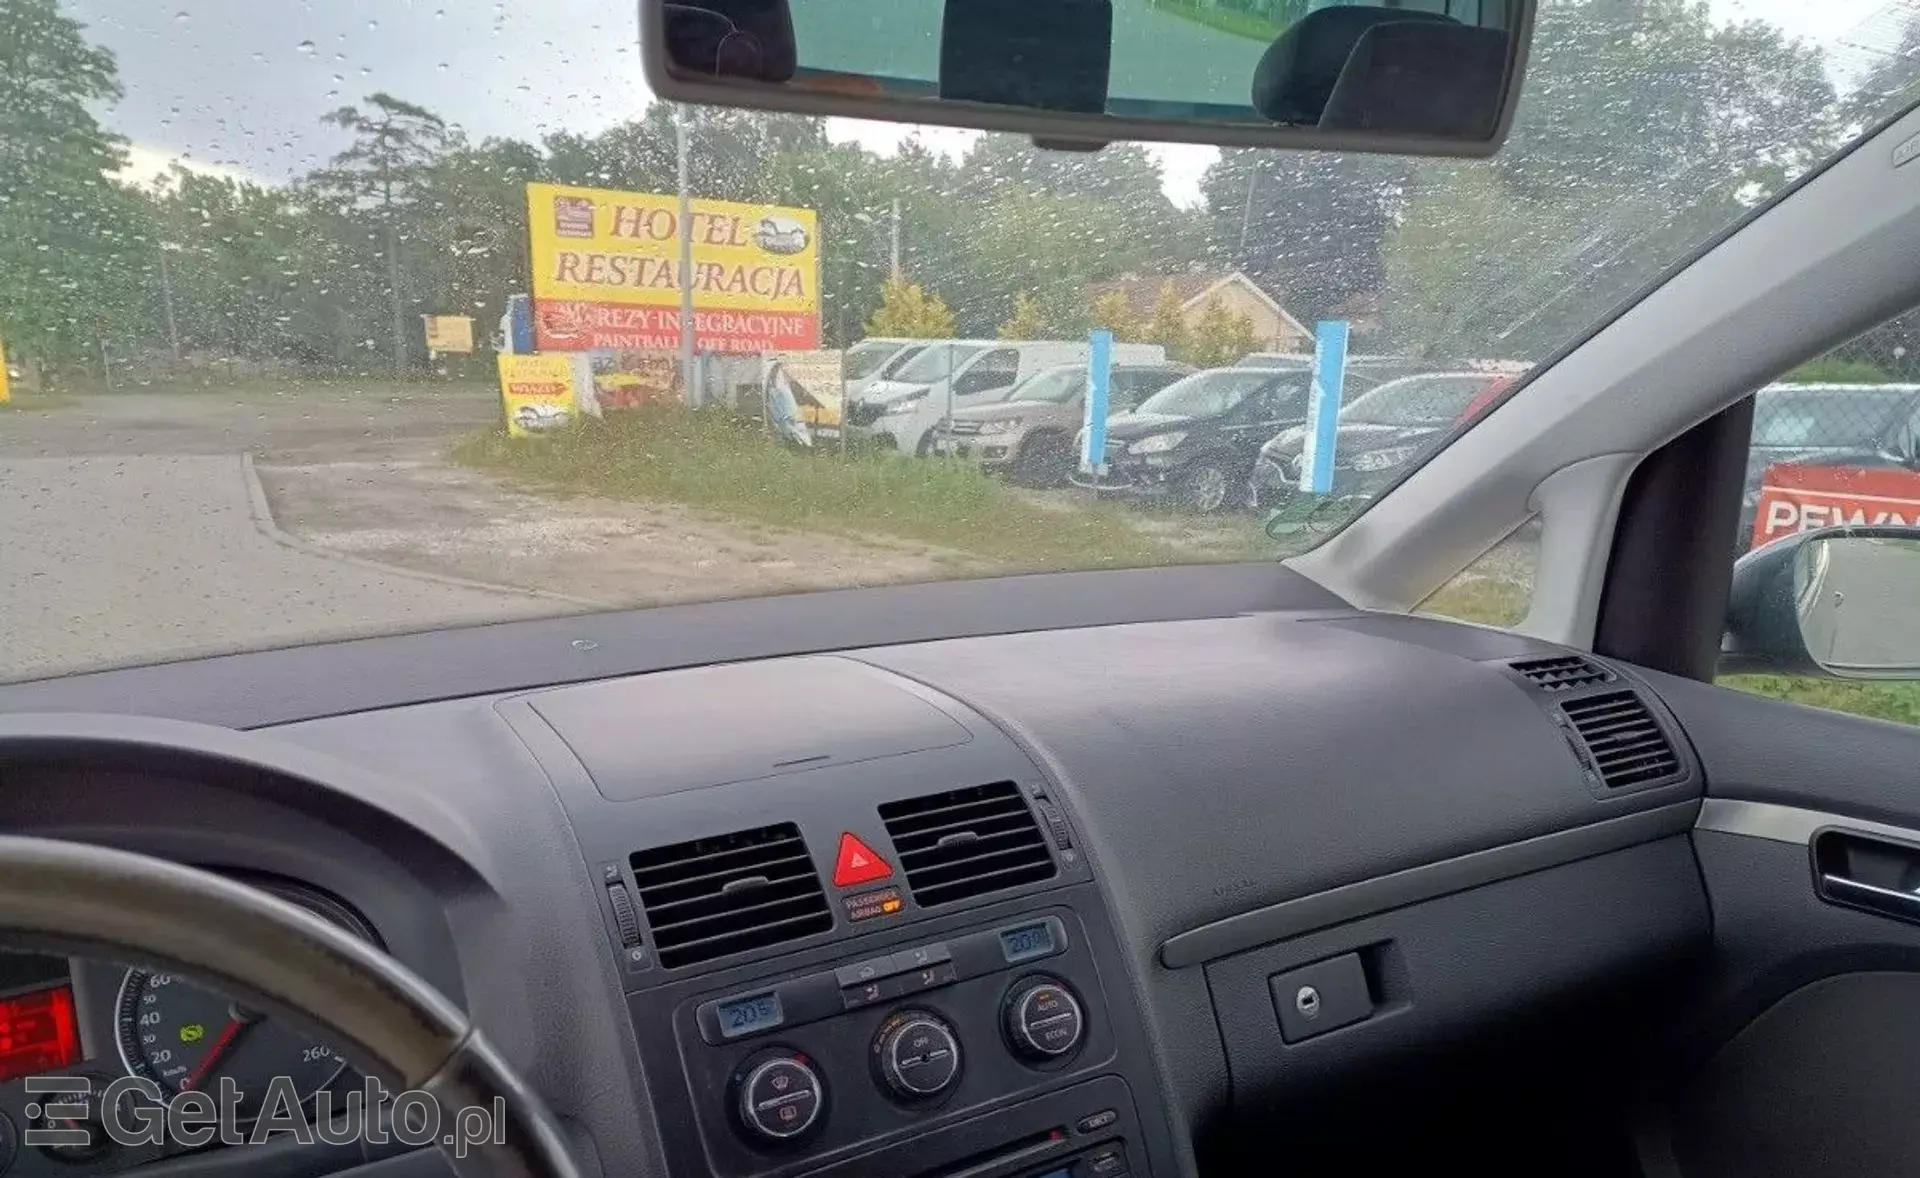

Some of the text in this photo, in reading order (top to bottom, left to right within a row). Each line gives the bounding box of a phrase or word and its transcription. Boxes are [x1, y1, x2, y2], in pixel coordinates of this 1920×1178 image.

[609, 205, 749, 247] HOTEL
[555, 251, 806, 301] RESTAURACJA
[657, 309, 805, 337] INEGRACYJNE
[140, 1011, 160, 1026] 40
[151, 1049, 172, 1064] 20
[302, 1045, 331, 1062] 260
